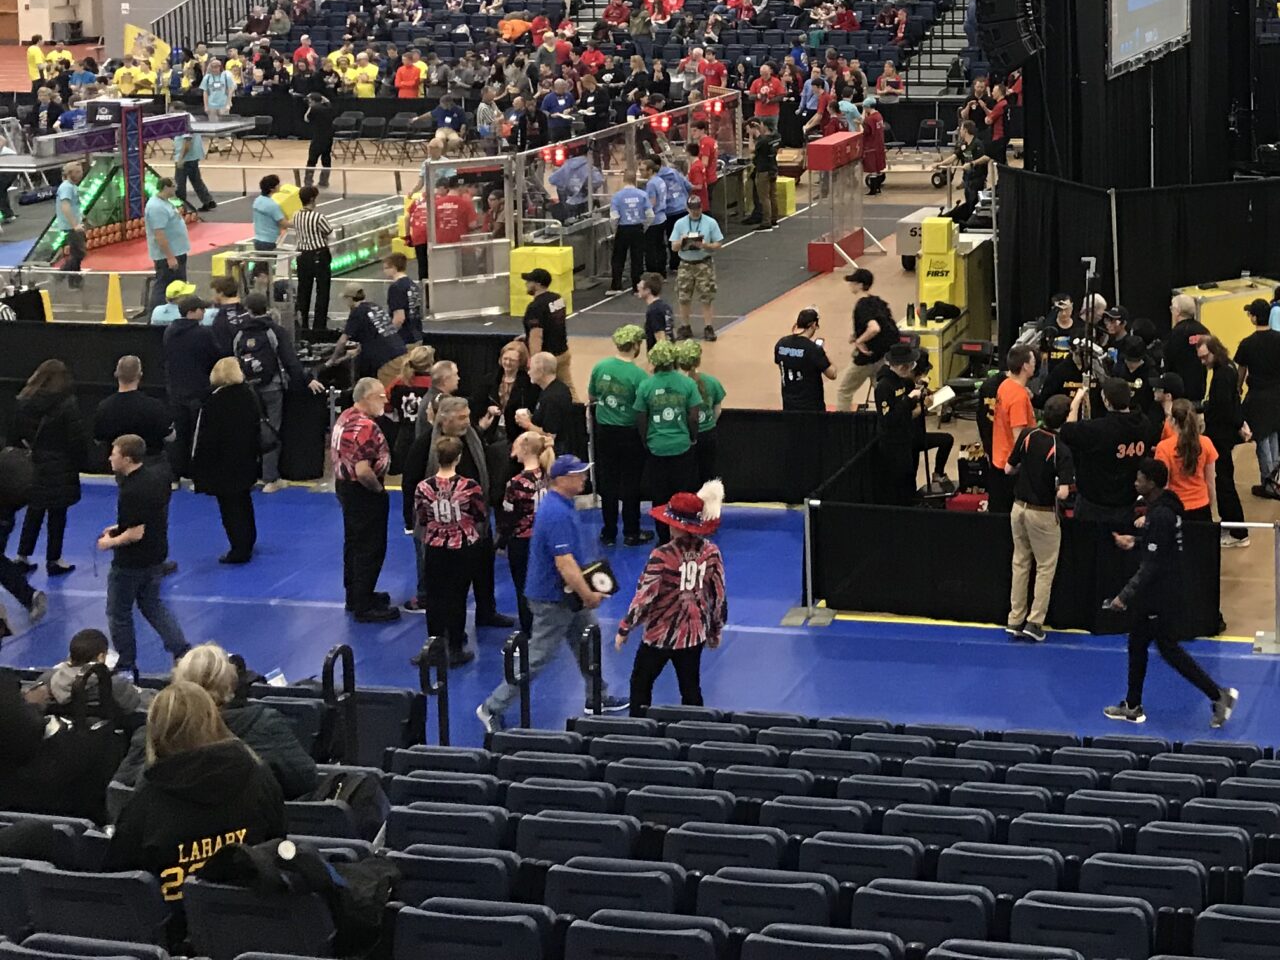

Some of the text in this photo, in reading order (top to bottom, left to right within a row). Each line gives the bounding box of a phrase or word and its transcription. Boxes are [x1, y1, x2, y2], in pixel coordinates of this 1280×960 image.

[1116, 441, 1145, 459] 340
[430, 499, 462, 523] 191
[678, 560, 707, 591] 191
